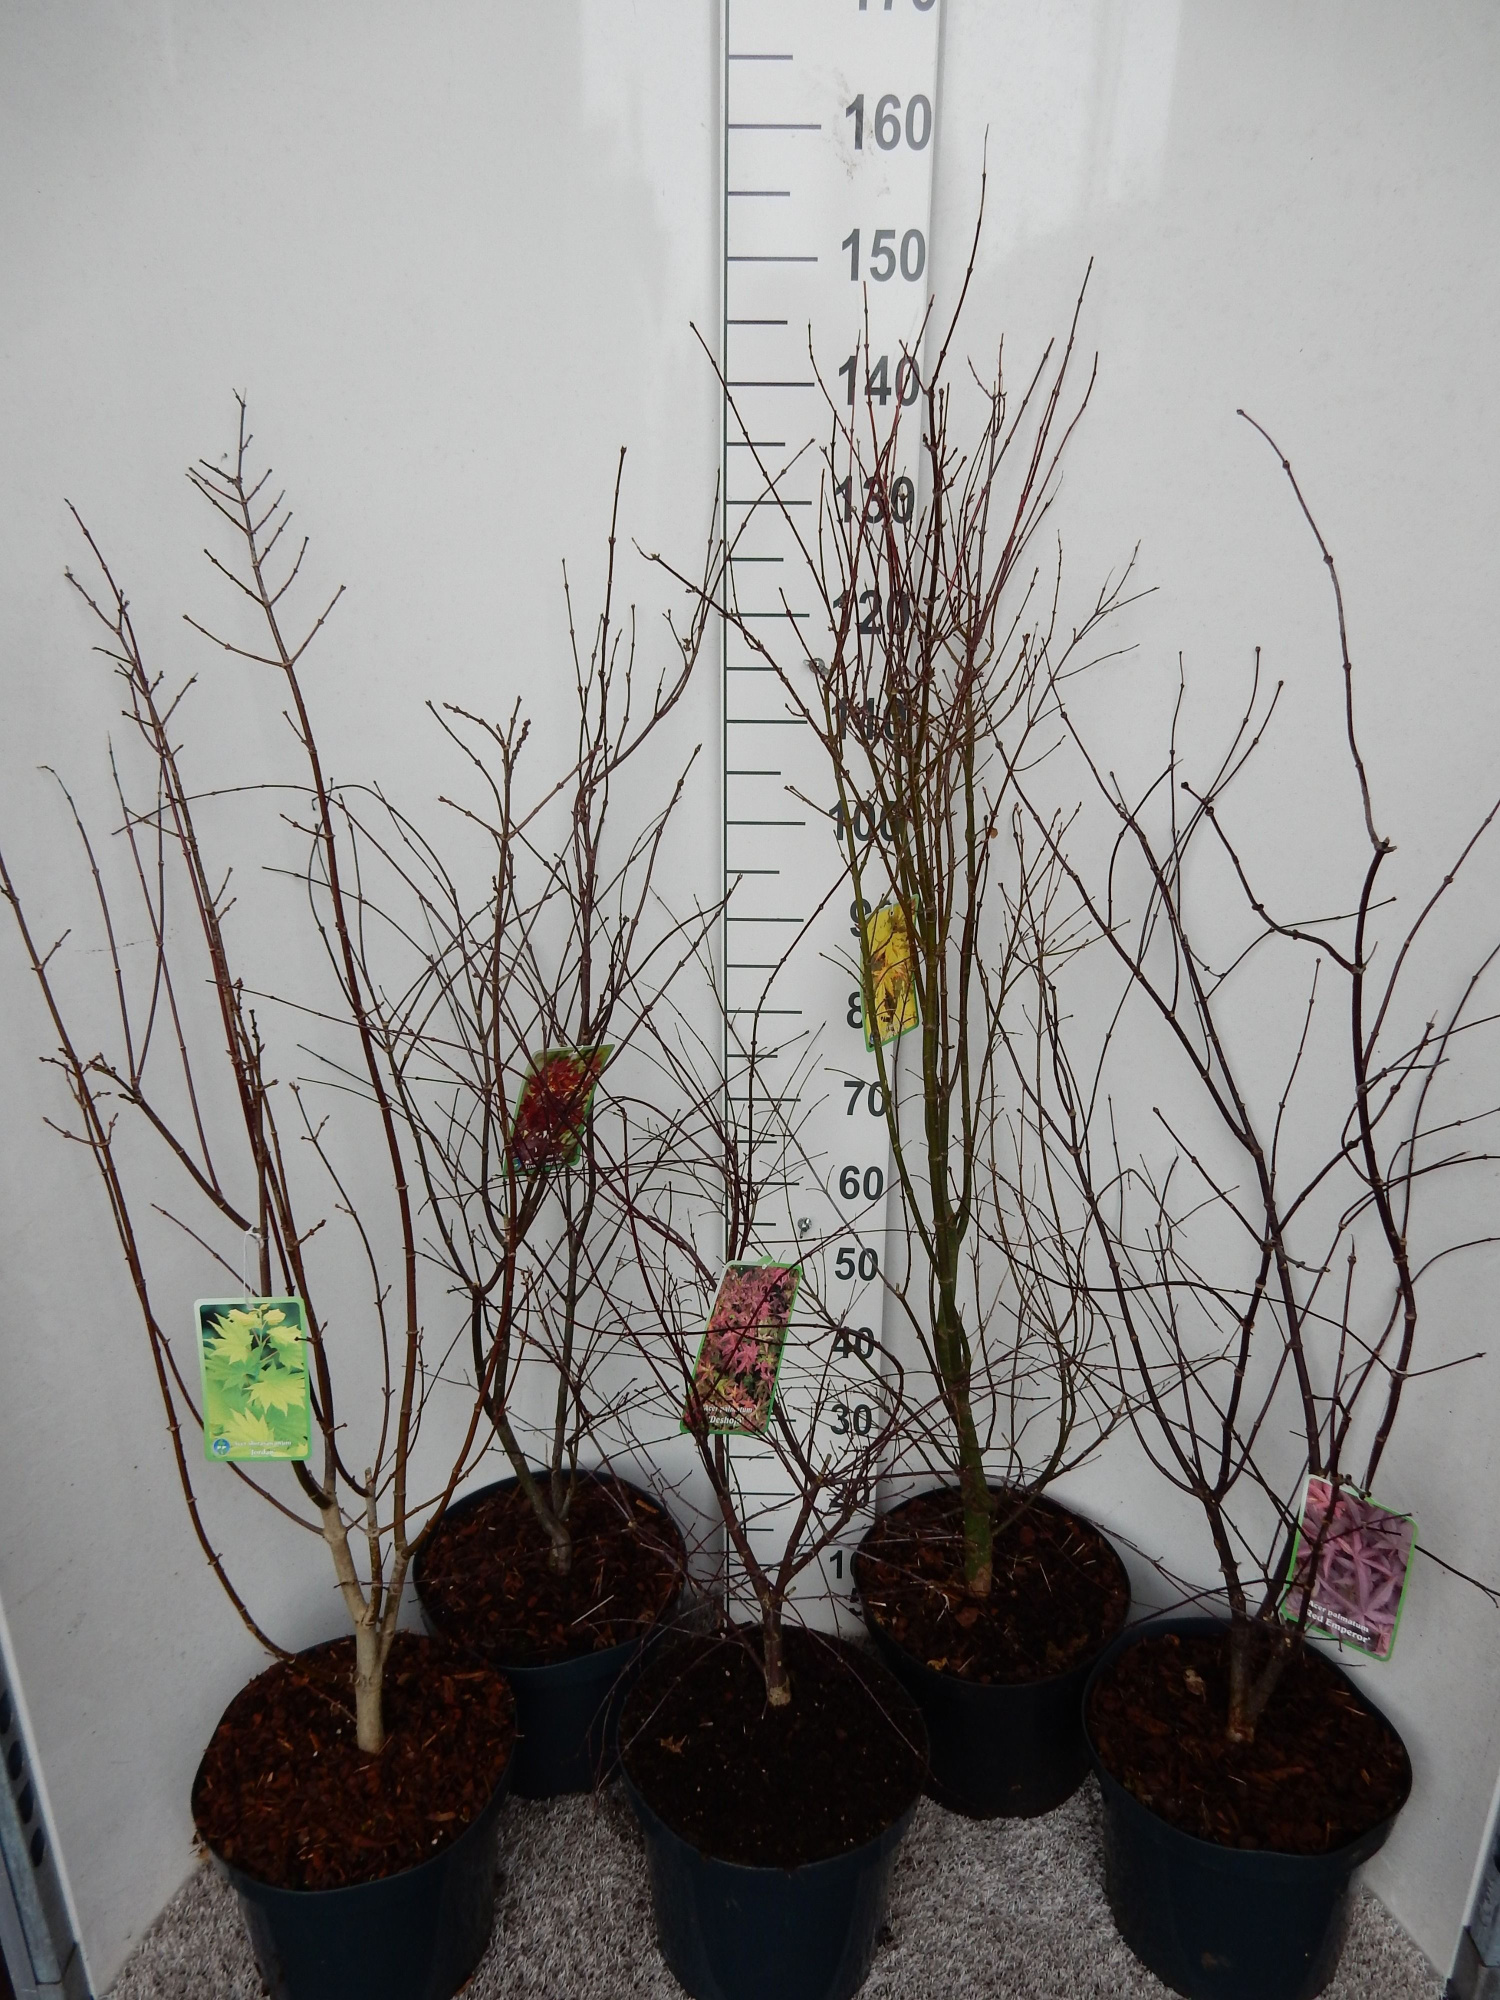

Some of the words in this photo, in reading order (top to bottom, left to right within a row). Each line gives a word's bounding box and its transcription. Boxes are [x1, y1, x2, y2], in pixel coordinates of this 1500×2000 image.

[845, 93, 932, 151] 160
[842, 228, 926, 283] 150
[838, 355, 920, 407] 140
[835, 475, 915, 524] 130
[832, 589, 910, 635] 120
[828, 799, 904, 842] 100
[846, 991, 864, 1029] 8
[843, 1080, 889, 1117] 70
[839, 1165, 884, 1201] 60
[834, 1247, 879, 1281] 50
[832, 1326, 875, 1360] 40
[830, 1403, 873, 1436] 30
[829, 1550, 843, 1579] 1
[1309, 1600, 1327, 1612] Acer
[1327, 1609, 1370, 1633] palmatum
